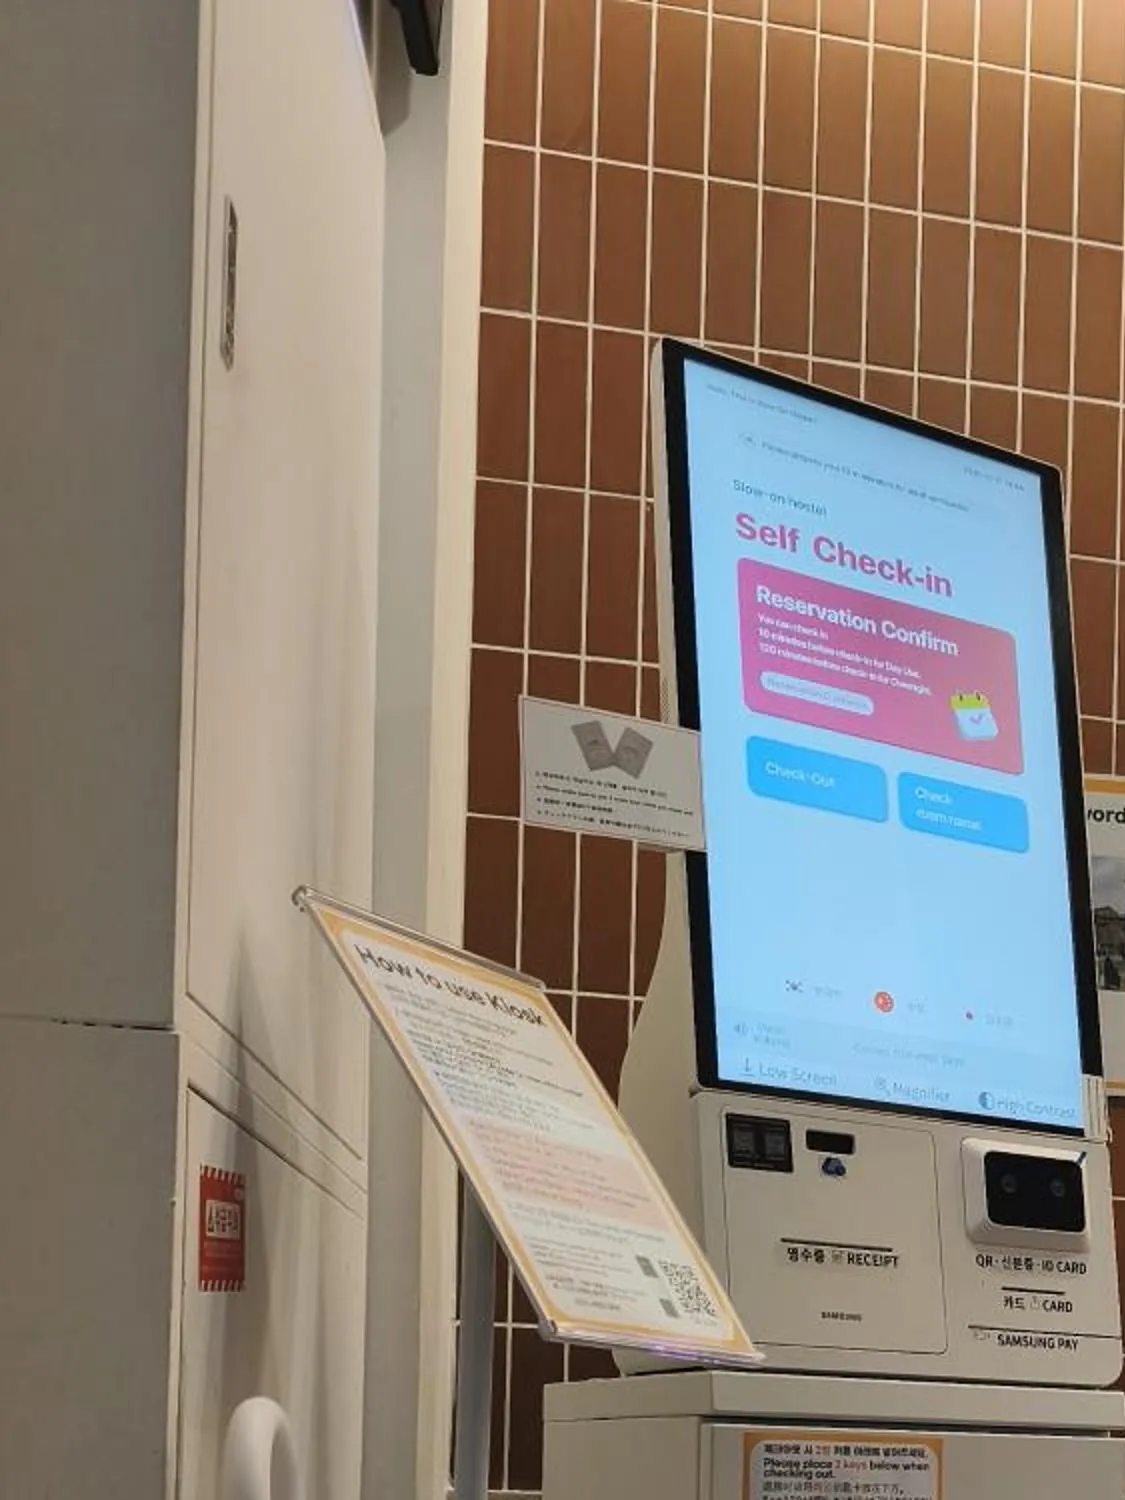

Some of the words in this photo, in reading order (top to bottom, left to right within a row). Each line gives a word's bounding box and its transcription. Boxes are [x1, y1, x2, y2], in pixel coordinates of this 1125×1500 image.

[735, 512, 800, 553] Self
[813, 536, 953, 598] Check-in
[756, 585, 877, 635] Reservation
[881, 620, 959, 657] Confirm
[354, 944, 413, 979] How
[415, 967, 443, 990] to
[444, 979, 487, 1006] use
[485, 991, 547, 1027] Kiosk
[847, 1252, 899, 1268] RECEIPT
[976, 1254, 993, 1269] QR
[1056, 1261, 1087, 1275] CARD
[1003, 1296, 1025, 1310] 카드
[1042, 1299, 1073, 1313] CARD
[997, 1333, 1055, 1349] SAMSUNG
[1058, 1338, 1079, 1351] PAY
[763, 1457, 801, 1470] Please
[802, 1459, 833, 1471] place
[869, 1461, 900, 1471] below
[901, 1462, 930, 1471] when
[763, 1469, 813, 1480] checking
